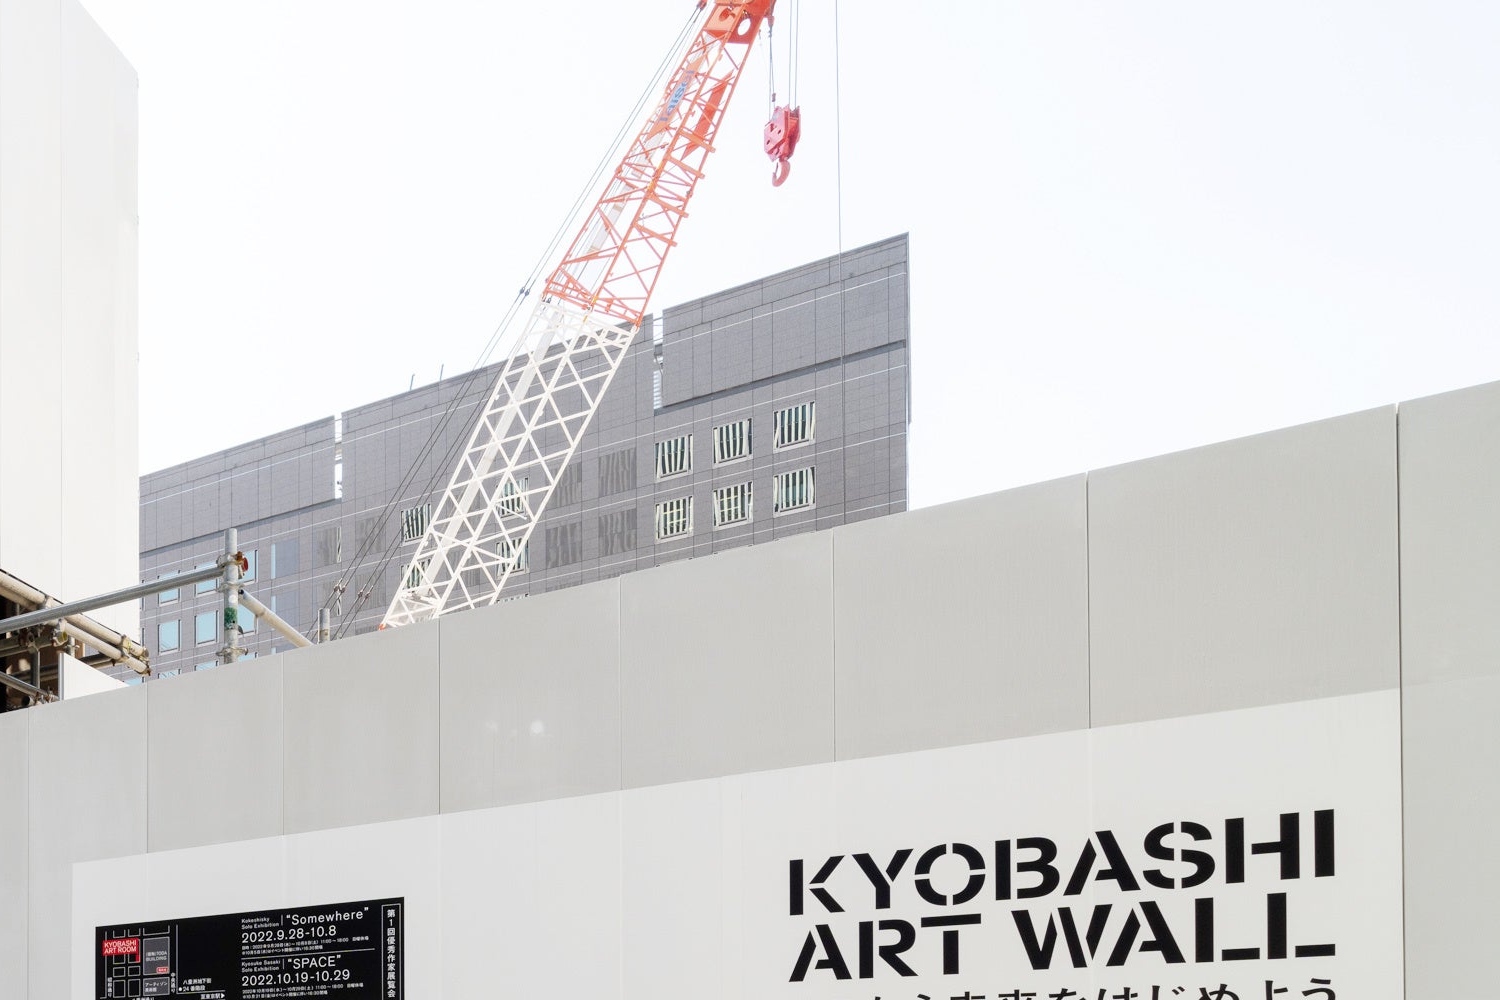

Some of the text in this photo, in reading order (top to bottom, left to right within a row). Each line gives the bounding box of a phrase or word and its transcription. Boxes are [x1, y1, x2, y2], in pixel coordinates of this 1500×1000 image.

[789, 808, 1335, 916] KYOBASHI
[104, 940, 136, 948] KYOBASHI
[241, 925, 337, 943] 2022.9.28-10.8
[386, 909, 396, 998] 第1回優秀作家展覧会
[789, 893, 1336, 982] ART WALL
[241, 969, 350, 987] 2022.10.19-10.29
